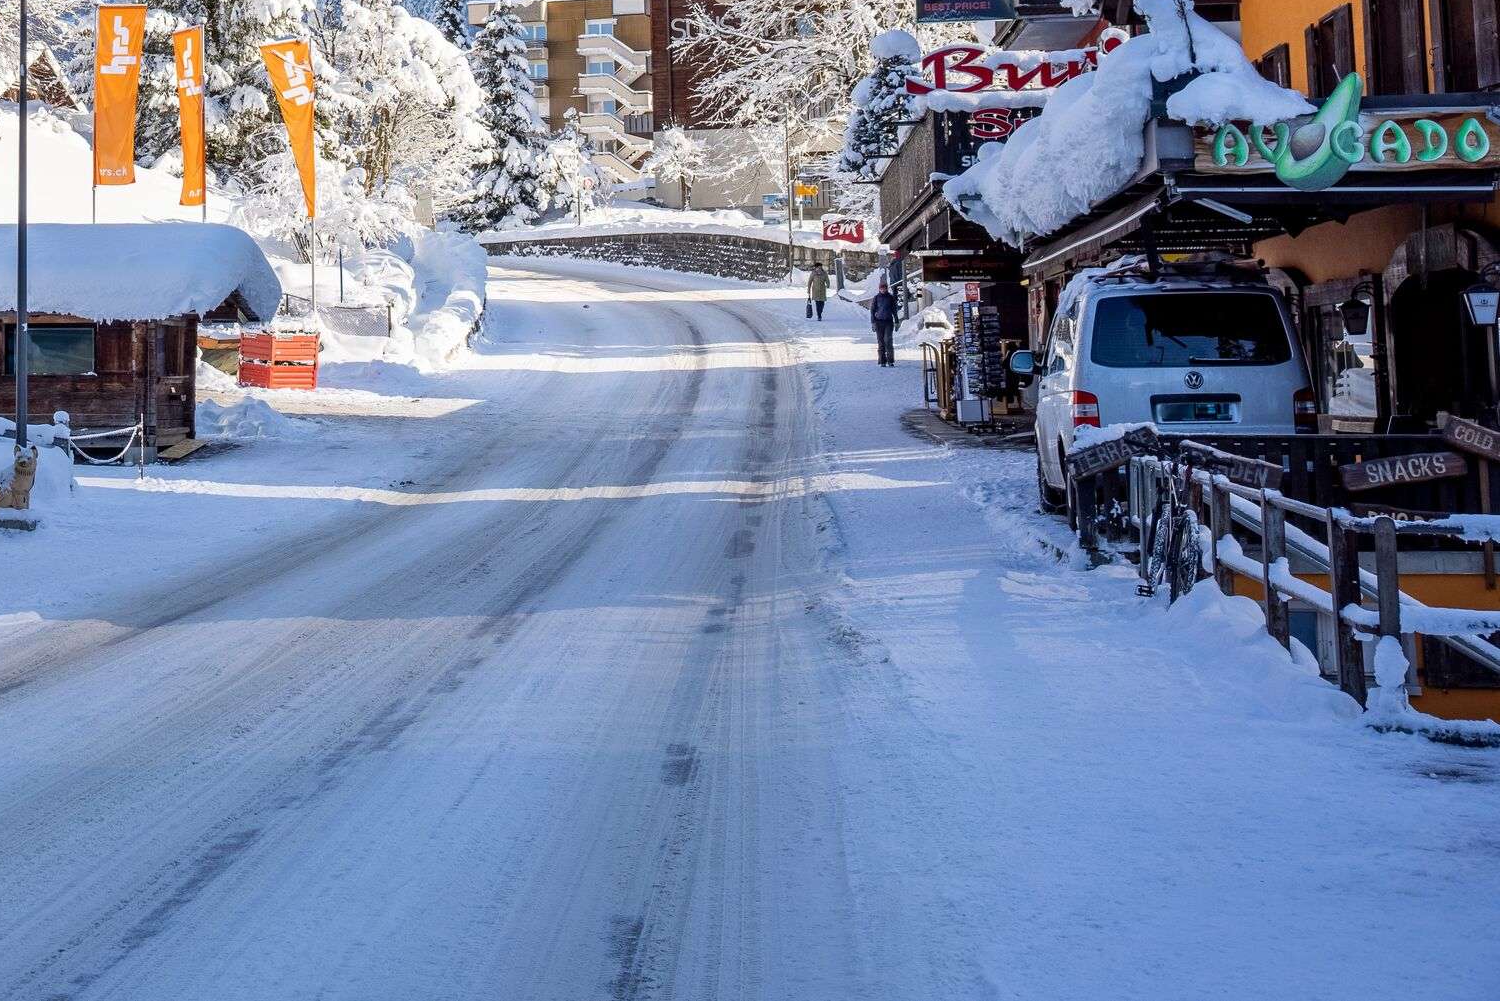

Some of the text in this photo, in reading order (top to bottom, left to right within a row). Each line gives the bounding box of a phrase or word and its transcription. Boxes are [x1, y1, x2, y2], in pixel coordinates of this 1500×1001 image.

[924, 1, 991, 11] BEST PRICE!
[1212, 112, 1490, 191] AVOCADO
[1454, 425, 1494, 450] COLD
[1365, 454, 1446, 484] SNACKS
